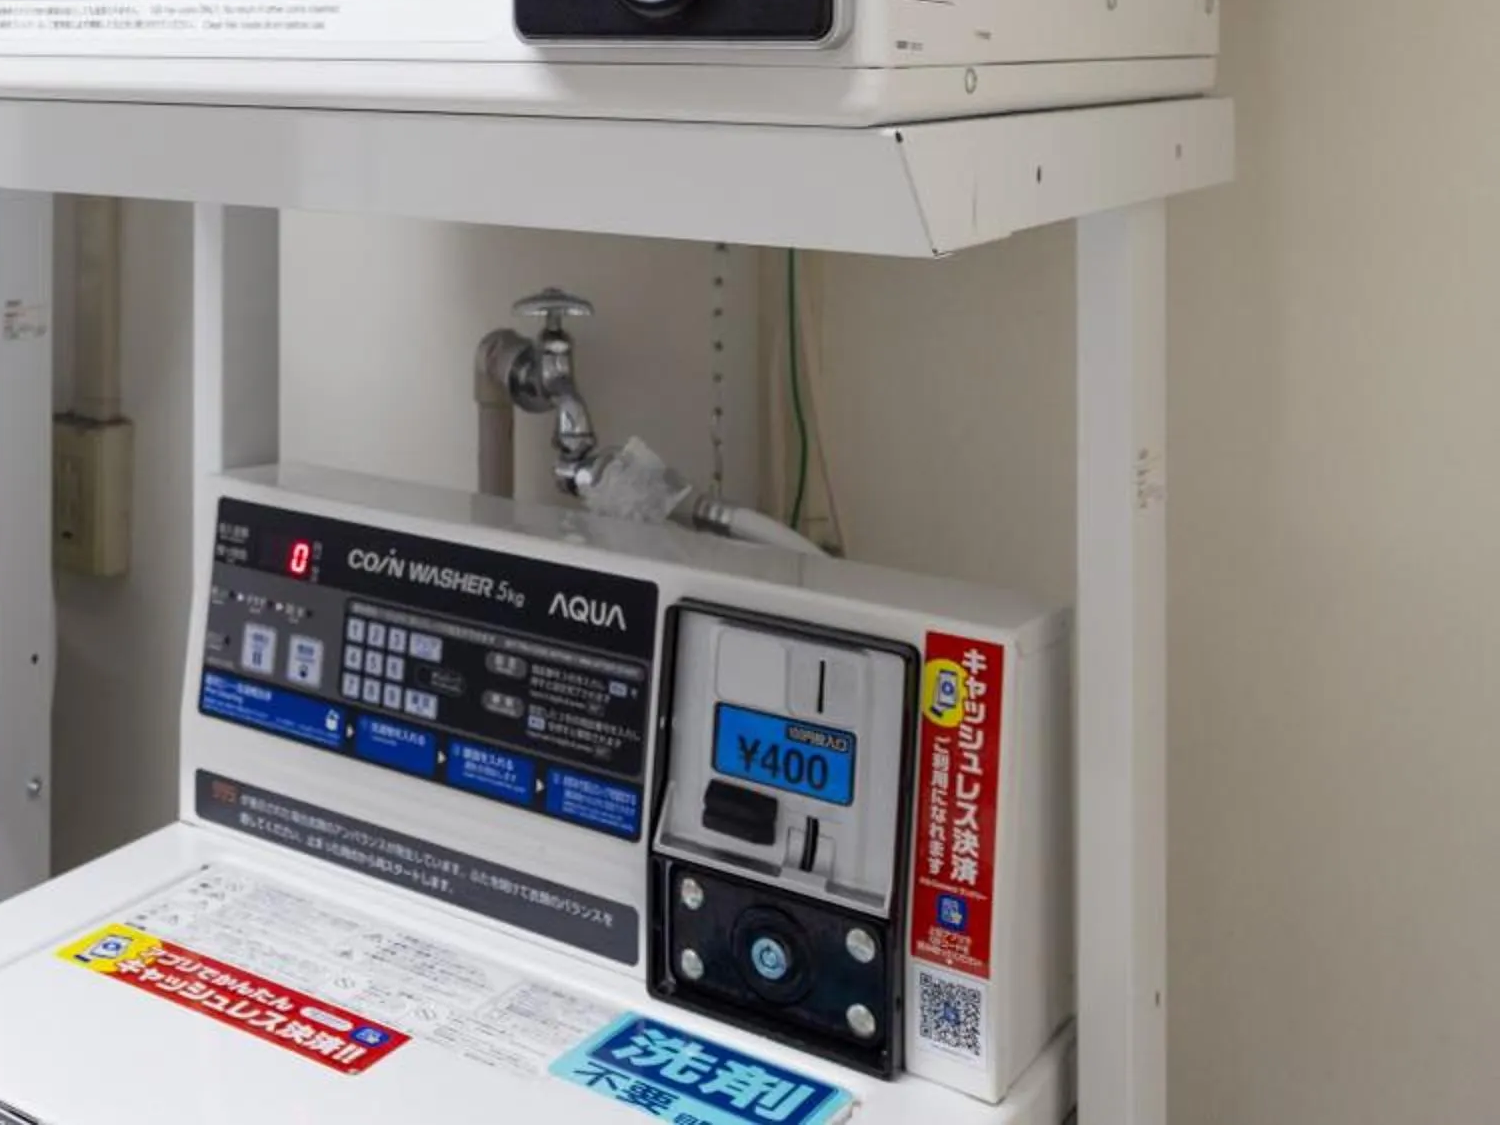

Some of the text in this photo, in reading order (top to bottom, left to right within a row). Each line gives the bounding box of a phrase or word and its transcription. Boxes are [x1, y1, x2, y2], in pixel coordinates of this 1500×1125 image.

[290, 543, 309, 573] 0
[408, 561, 494, 597] WASHER
[495, 580, 526, 608] 5kg
[548, 591, 628, 632] AQUA
[738, 734, 828, 791] ¥400
[949, 648, 988, 885] キャッシュレス決済
[138, 946, 296, 1012] アプリでかんたん
[573, 1061, 680, 1116] 不要
[610, 1027, 816, 1121] 洗剤
